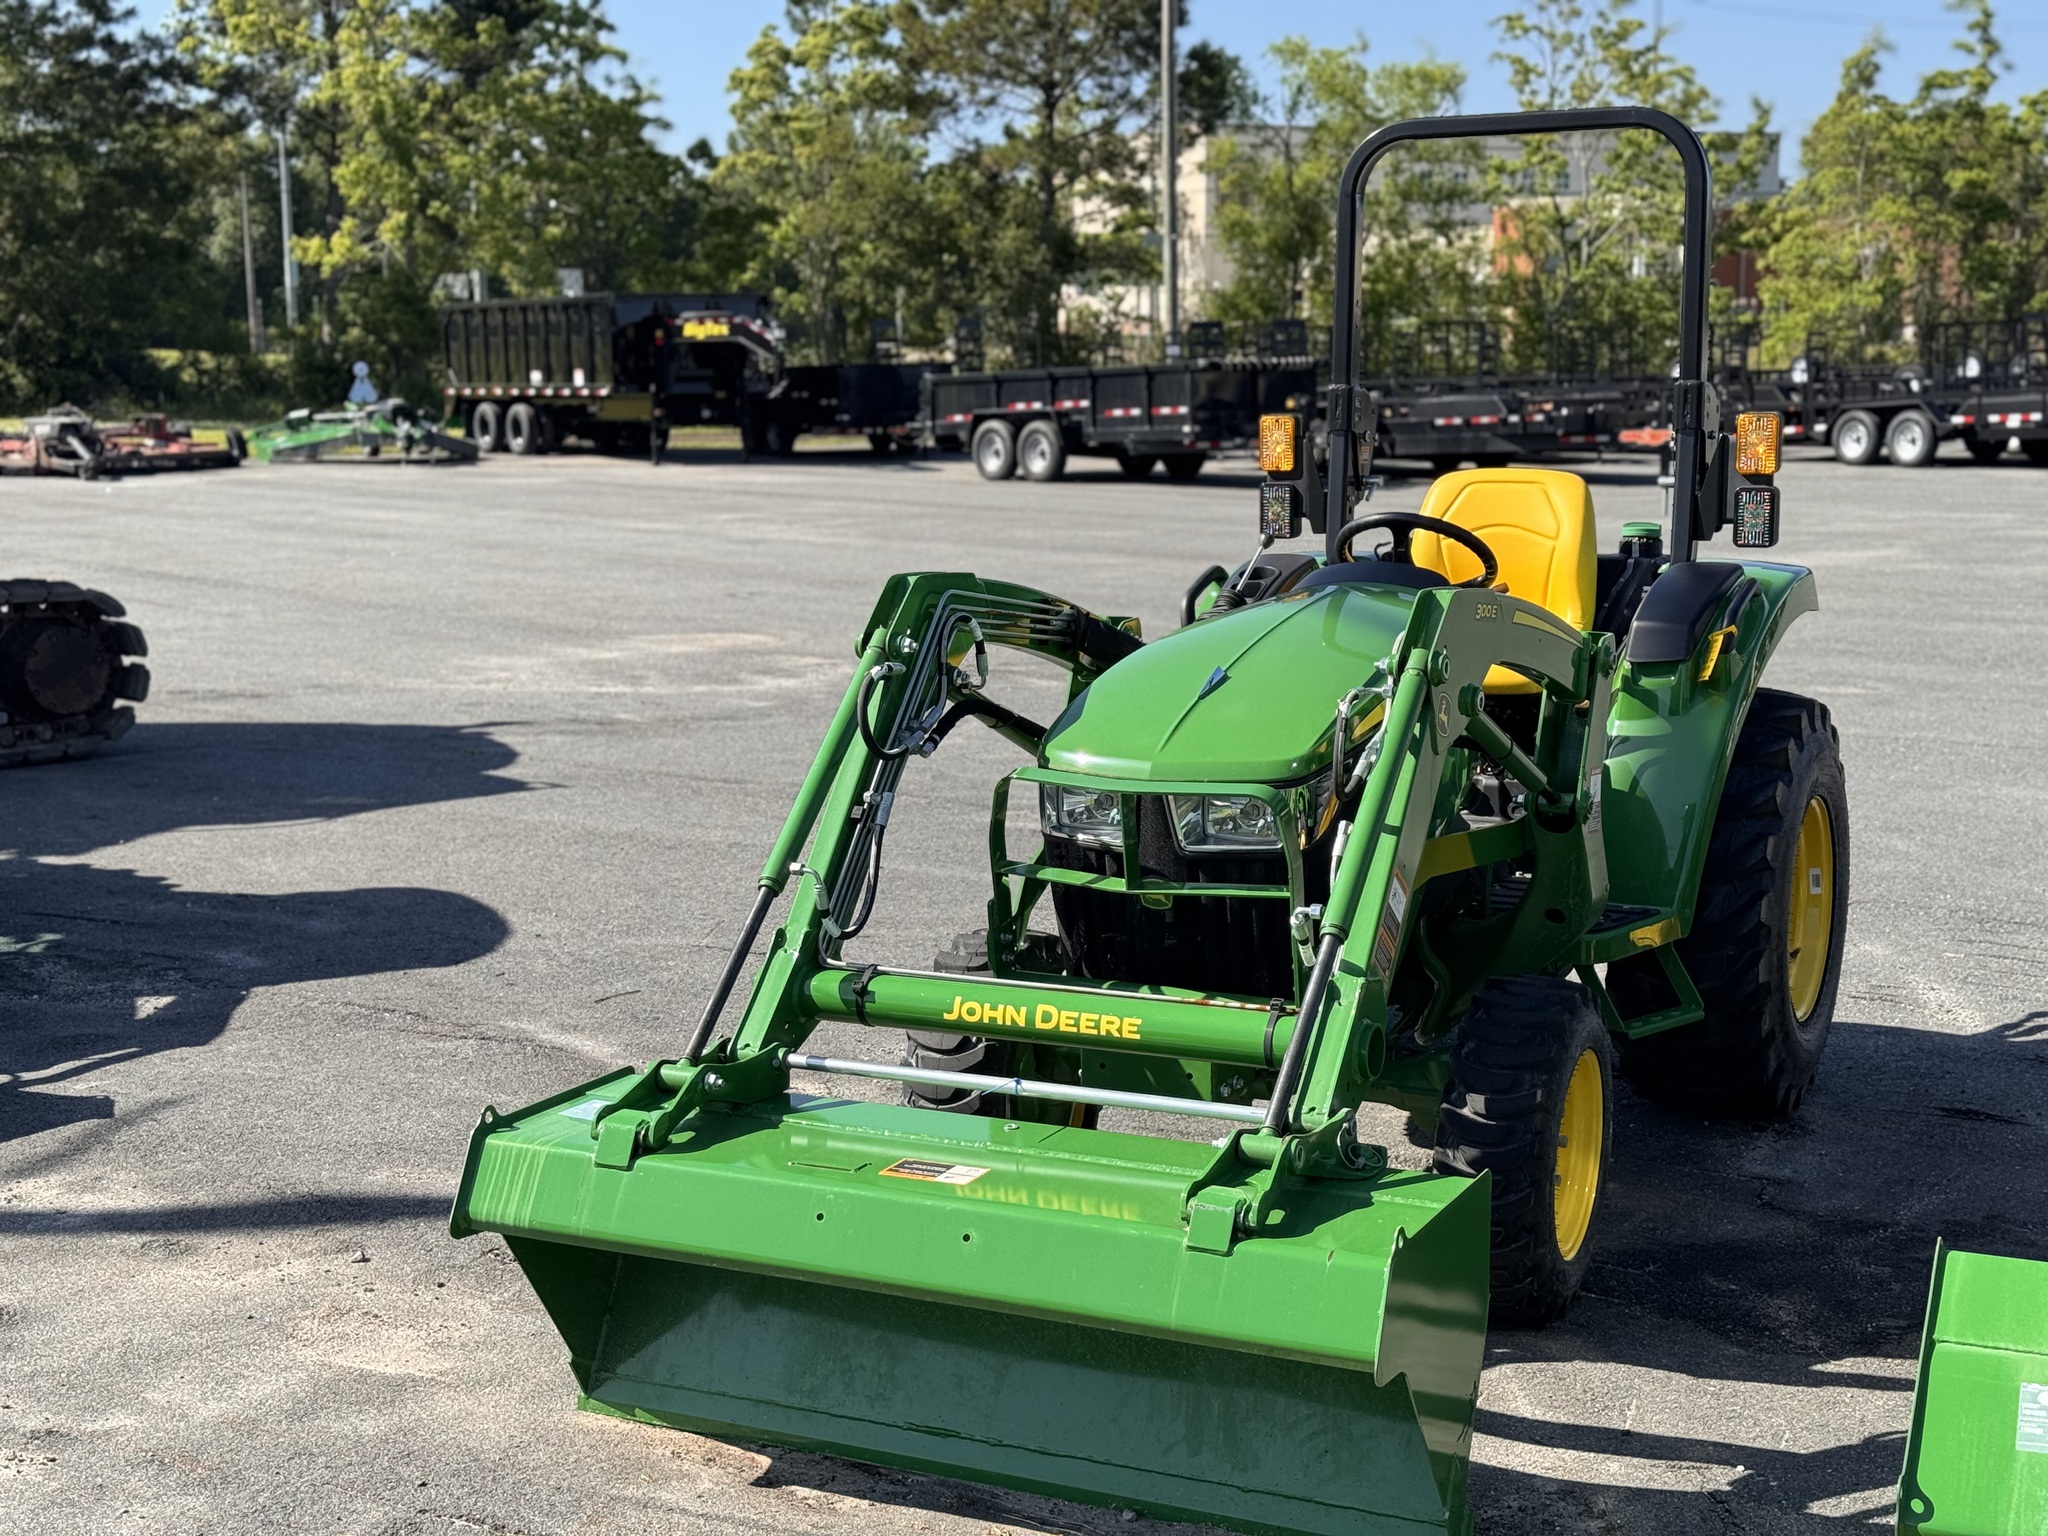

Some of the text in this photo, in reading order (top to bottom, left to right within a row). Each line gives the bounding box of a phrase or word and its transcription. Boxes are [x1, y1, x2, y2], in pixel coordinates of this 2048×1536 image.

[1475, 603, 1498, 619] 300E
[943, 996, 1143, 1040] JOHN DEERE
